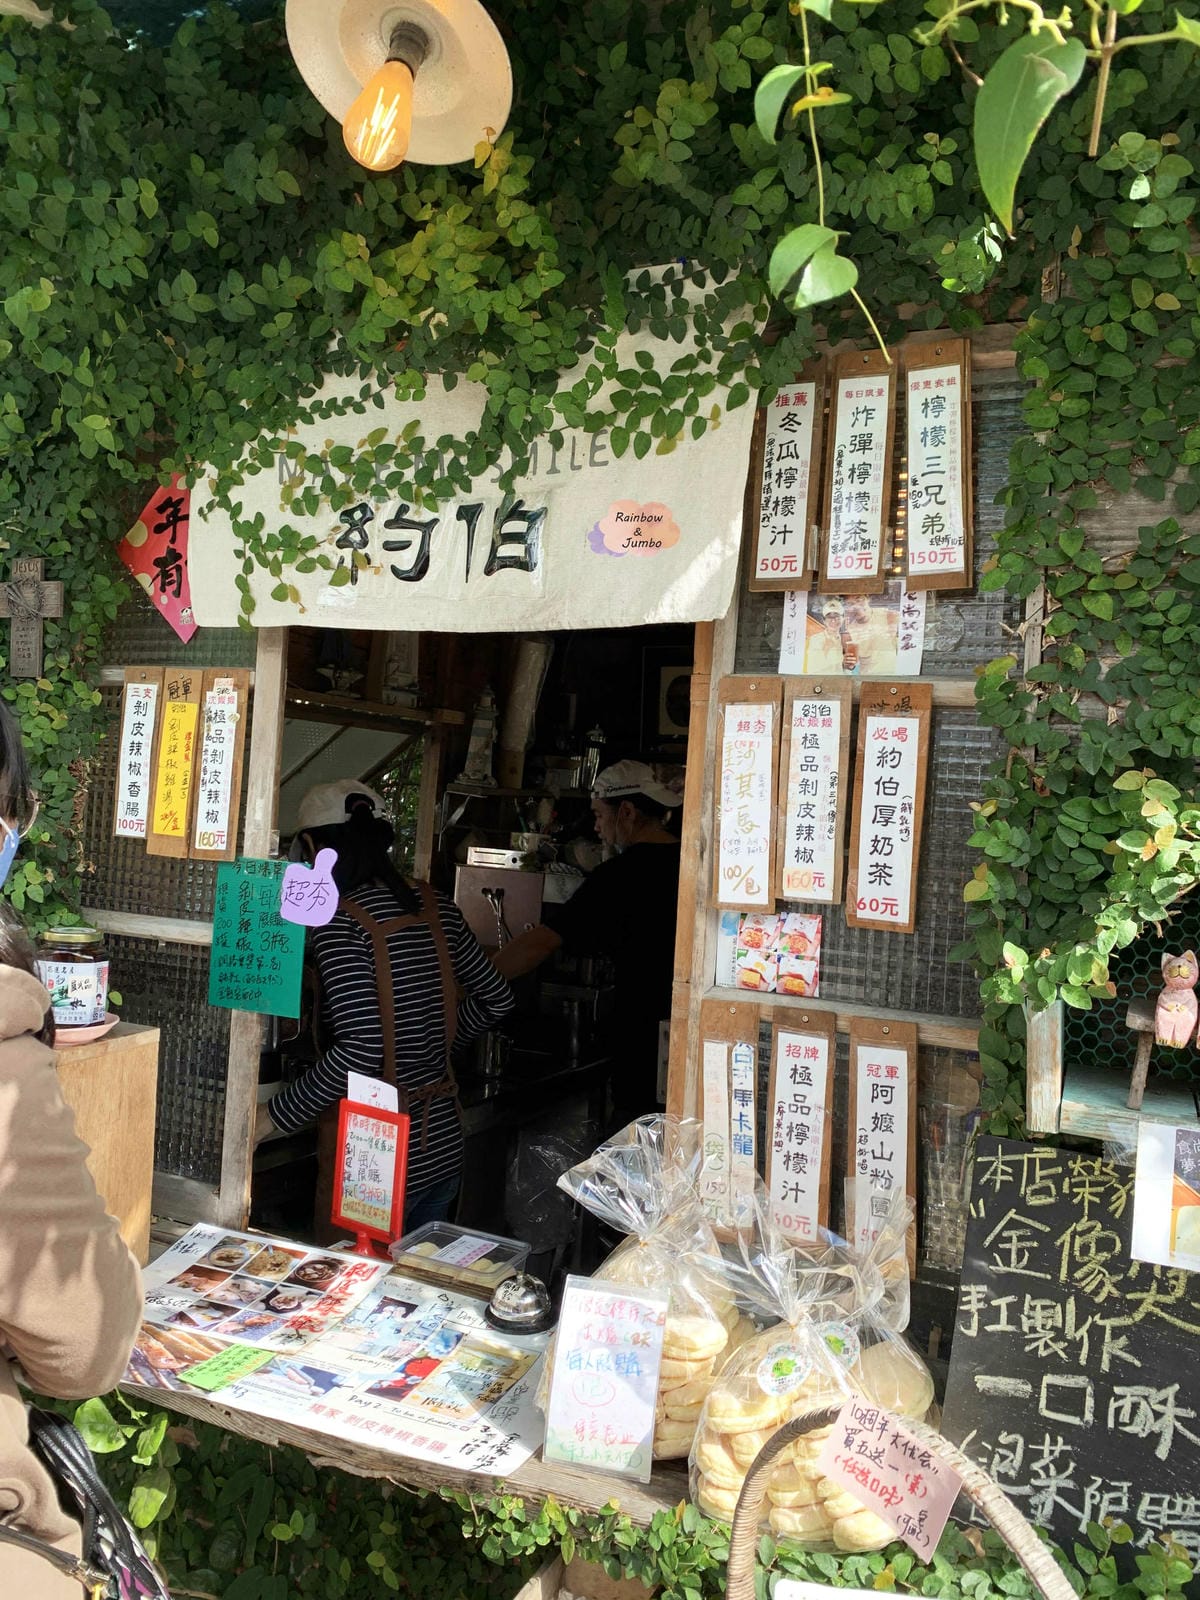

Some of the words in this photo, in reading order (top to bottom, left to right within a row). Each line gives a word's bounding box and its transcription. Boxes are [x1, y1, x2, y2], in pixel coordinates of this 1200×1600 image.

[910, 377, 957, 391] 優惠套組
[776, 391, 808, 408] 推薦
[845, 388, 885, 399] 每日限量
[844, 405, 876, 541] 炸彈檸檬茶
[920, 395, 947, 535] 檸檬三兄弟
[770, 411, 802, 546] 冬瓜檸檬汁
[615, 511, 663, 523] Rainbow
[633, 528, 642, 536] &
[622, 538, 663, 549] Jumbo
[760, 555, 798, 573] 50元
[833, 552, 873, 570] 50元
[910, 547, 957, 565] 150元
[13, 560, 39, 574] JESUS
[131, 688, 152, 698] 三支
[168, 679, 192, 699] 冠軍
[736, 720, 766, 733] 超夯
[872, 727, 908, 742] 必喝
[125, 700, 148, 817] 剝皮辣椒香腸
[205, 710, 226, 824] 極品剝皮辣椒
[794, 733, 820, 864] 極品剝皮辣椒
[868, 746, 902, 886] 約伯厚奶茶
[118, 819, 145, 832] 100元
[198, 831, 226, 848] 160元
[284, 877, 330, 911] 超夯
[856, 897, 899, 916] 60元
[785, 1043, 820, 1061] 招牌
[866, 1063, 899, 1080] 冠軍
[780, 1064, 813, 1204] 極品檸檬汁
[959, 1284, 1142, 1373] 手工製作
[348, 1394, 372, 1408] Day
[974, 1373, 1200, 1462] 一口酥
